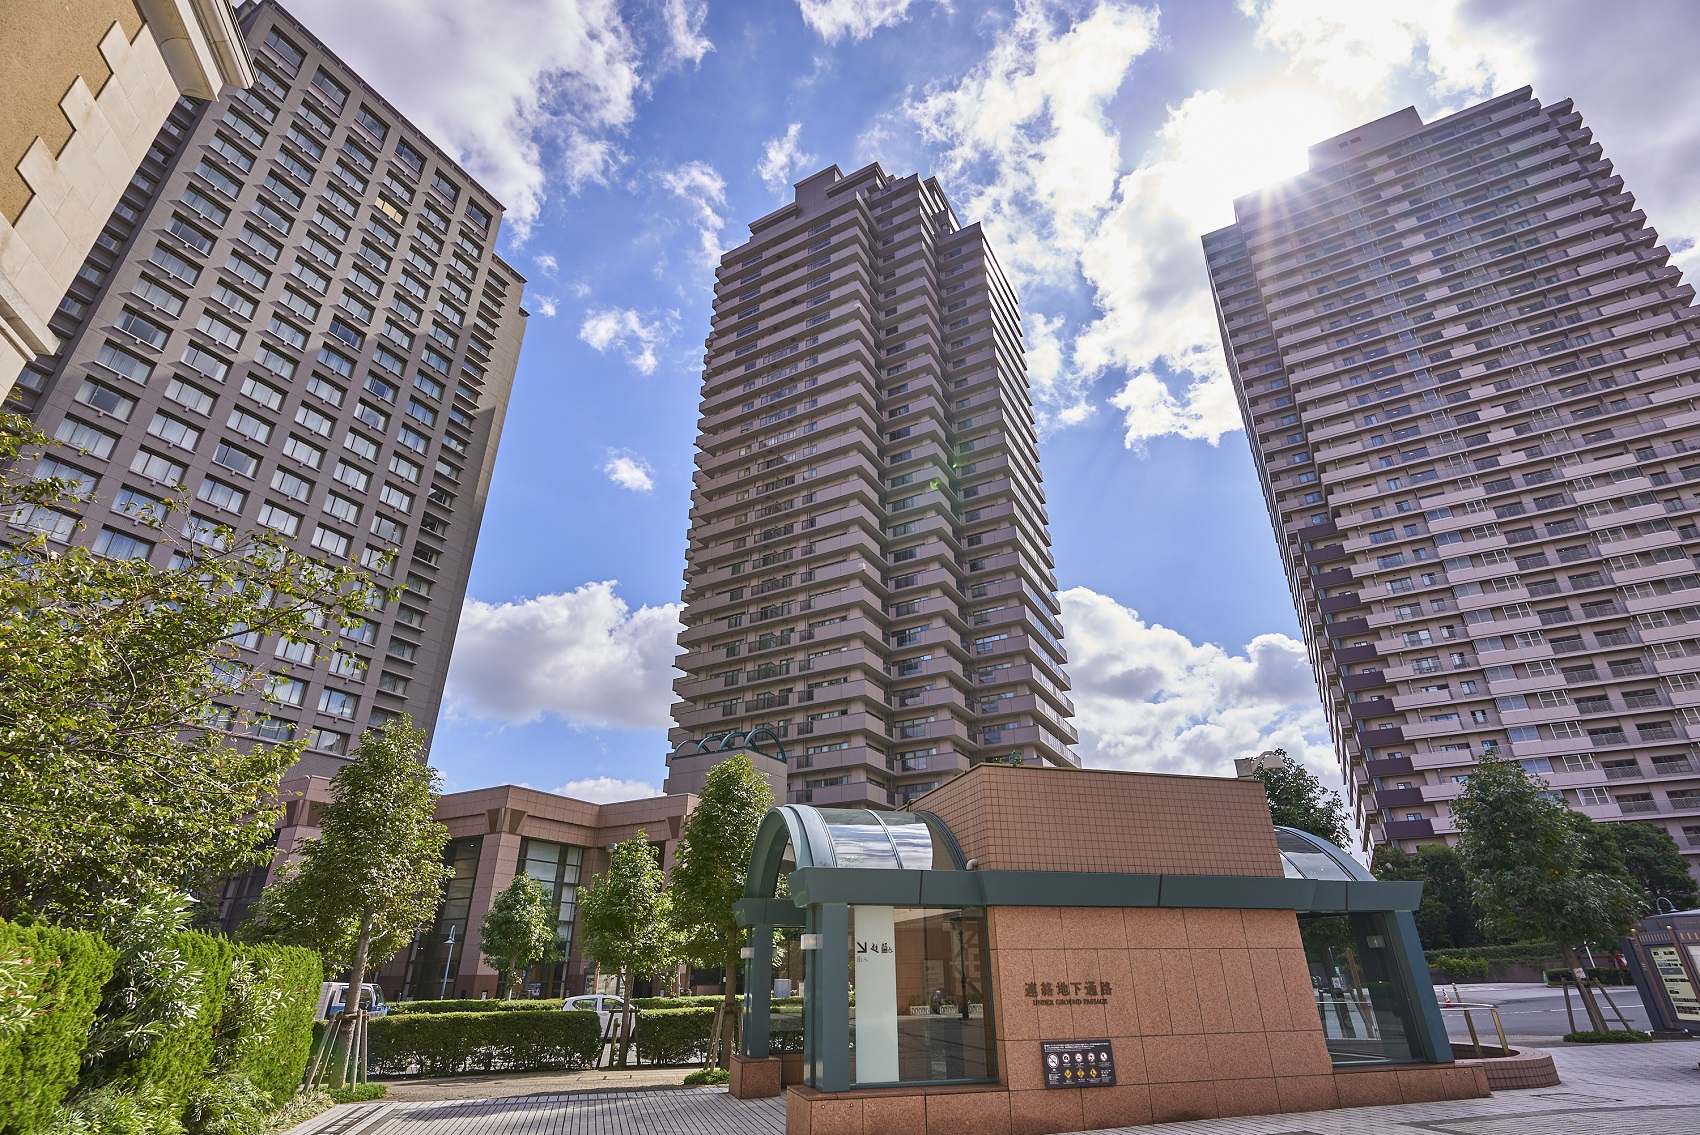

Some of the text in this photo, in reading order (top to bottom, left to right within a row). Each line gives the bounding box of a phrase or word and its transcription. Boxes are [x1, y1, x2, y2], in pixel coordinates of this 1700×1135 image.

[1025, 981, 1112, 997] 連絡地下通路
